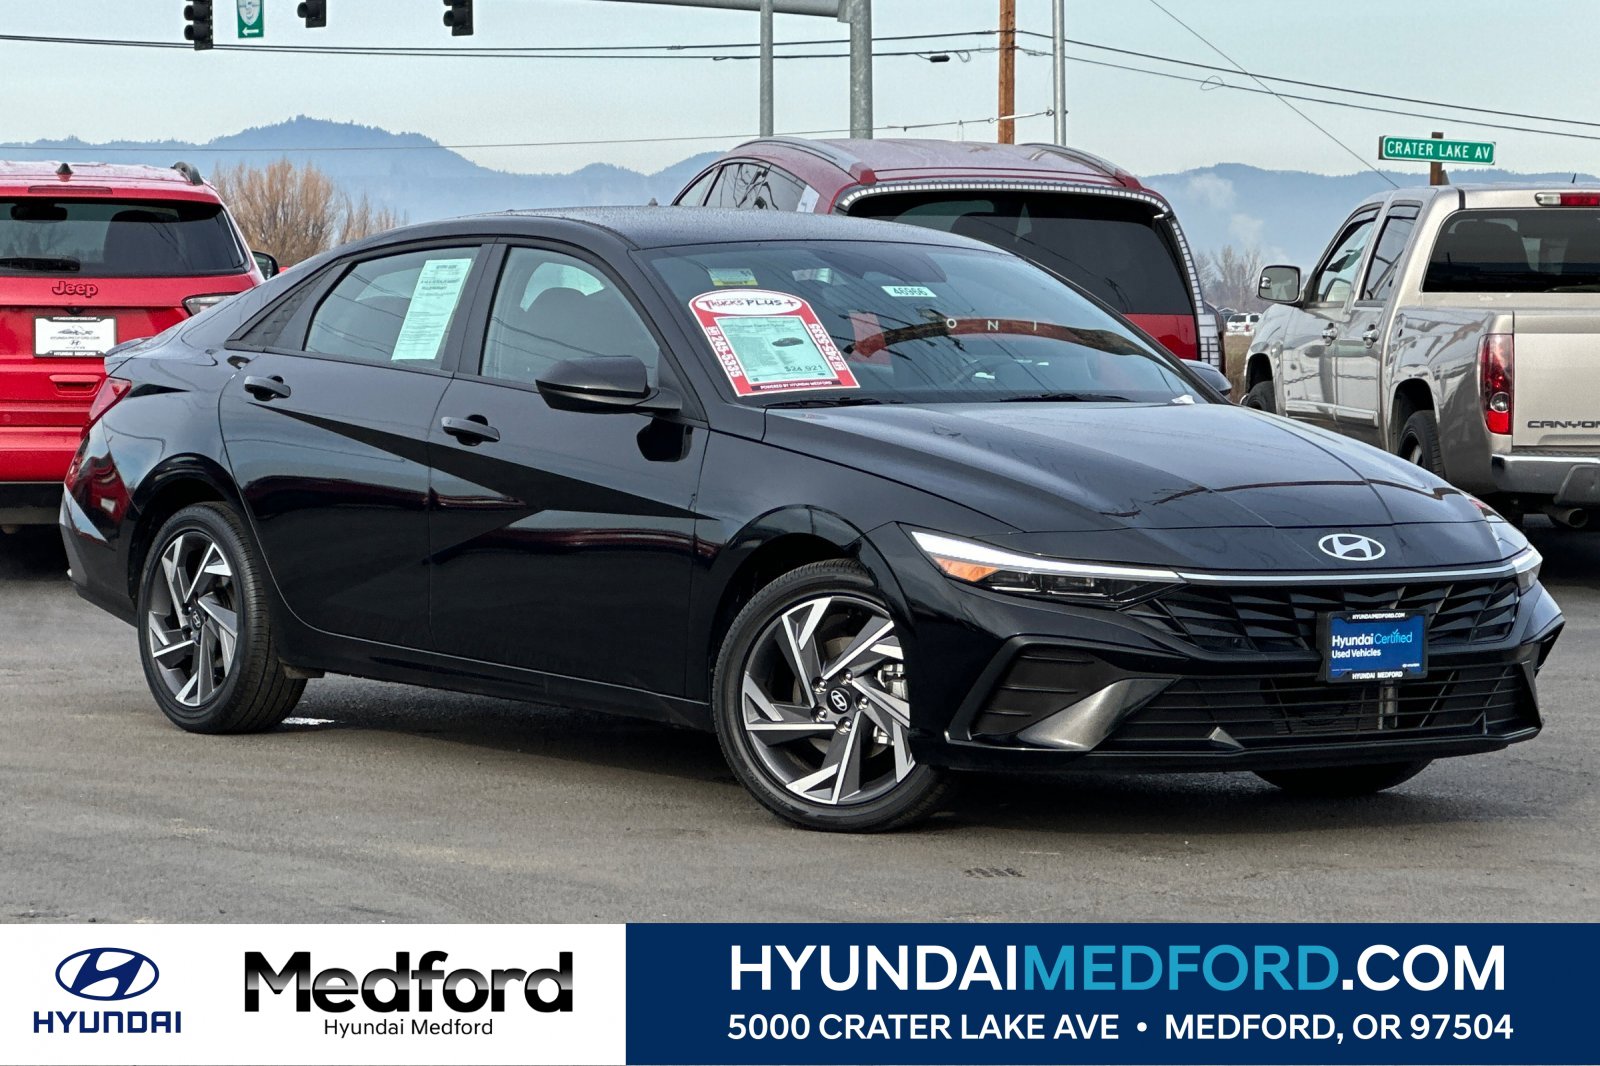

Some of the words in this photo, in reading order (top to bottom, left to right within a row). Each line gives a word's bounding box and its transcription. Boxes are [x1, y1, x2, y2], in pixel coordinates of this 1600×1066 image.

[1386, 140, 1434, 156] CRATER
[1439, 144, 1470, 158] LAKE
[1474, 146, 1491, 160] AV
[52, 281, 98, 298] Jeep
[1332, 633, 1374, 649] Hyundai
[1374, 629, 1413, 645] Certified
[1331, 650, 1351, 659] Used
[1351, 648, 1382, 658] Vehicles
[1352, 672, 1376, 680] HYUNDAI
[1377, 670, 1404, 679] MEDFORD
